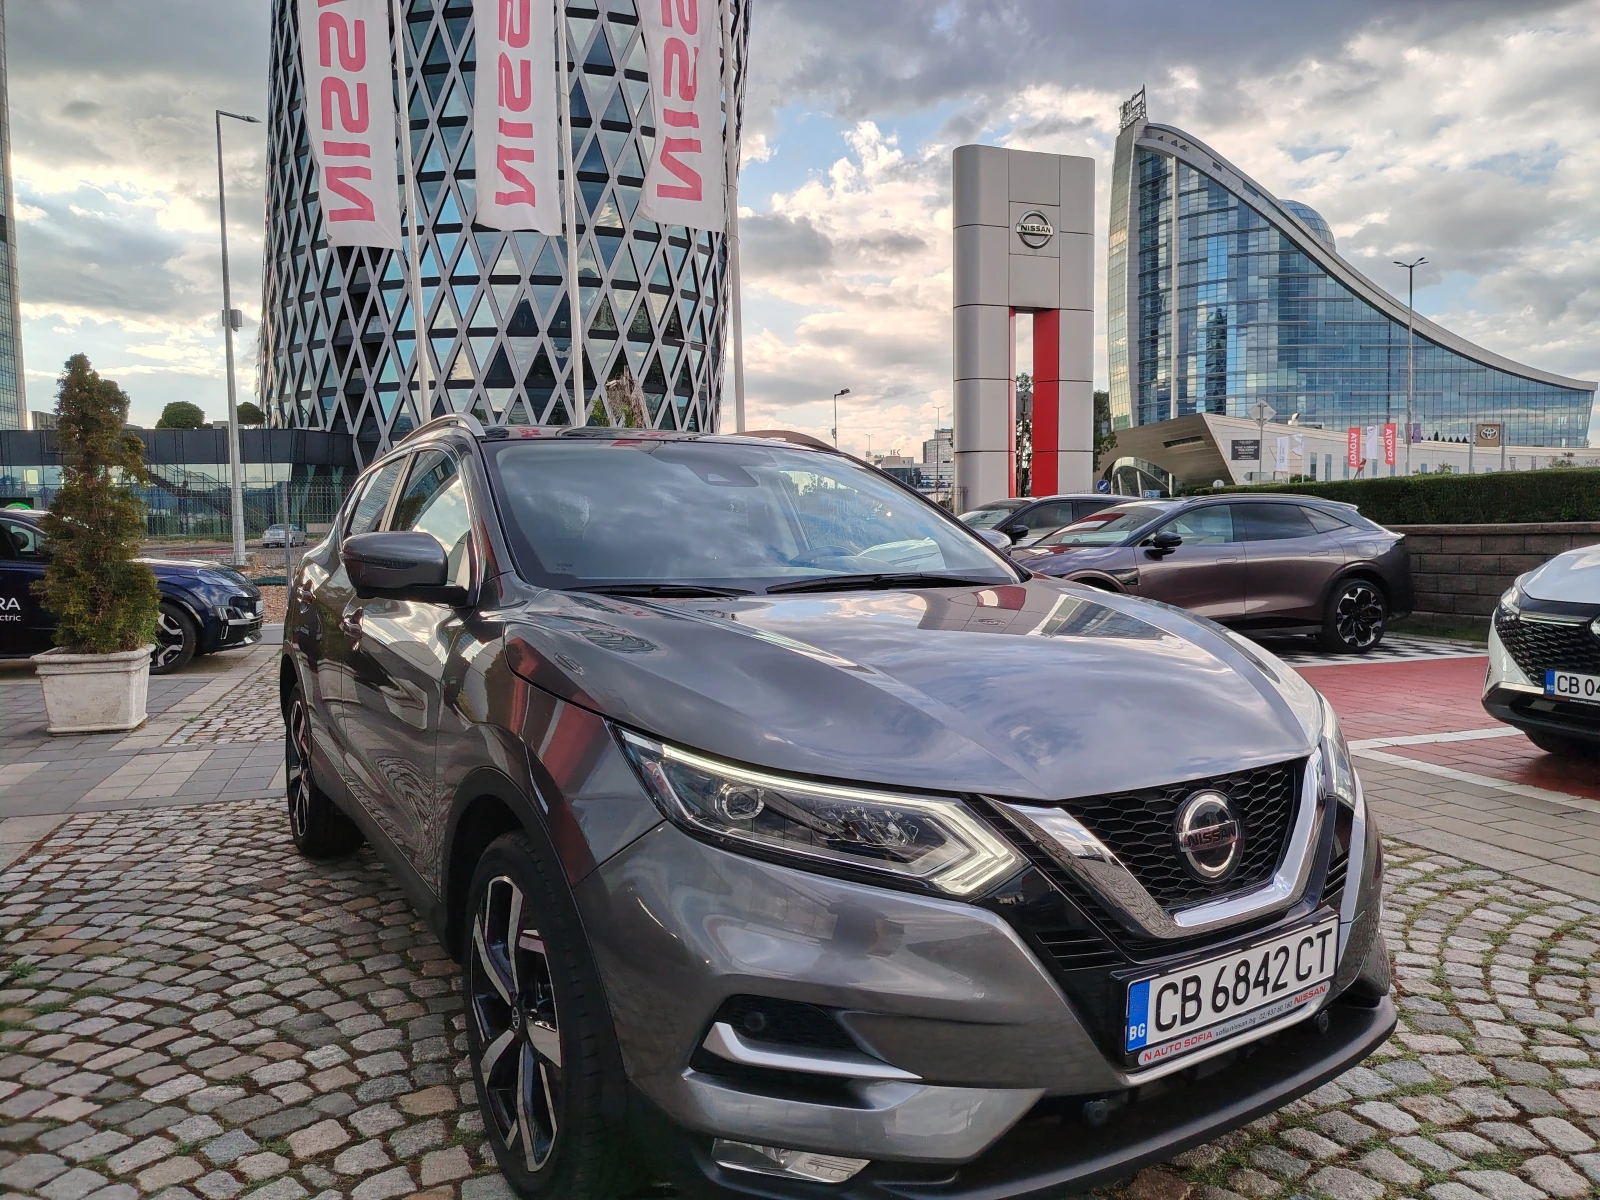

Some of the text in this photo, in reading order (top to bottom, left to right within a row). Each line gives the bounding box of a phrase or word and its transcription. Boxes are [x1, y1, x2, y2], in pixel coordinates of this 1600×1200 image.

[1020, 225, 1051, 233] NISSAN
[1557, 675, 1579, 694] CB
[1154, 927, 1334, 1032] CB 6842 CT
[1154, 1042, 1182, 1058] AUTO
[1184, 1031, 1213, 1048] SOFIA
[1294, 985, 1326, 1004] NISSAN
[1129, 1022, 1146, 1041] BG
